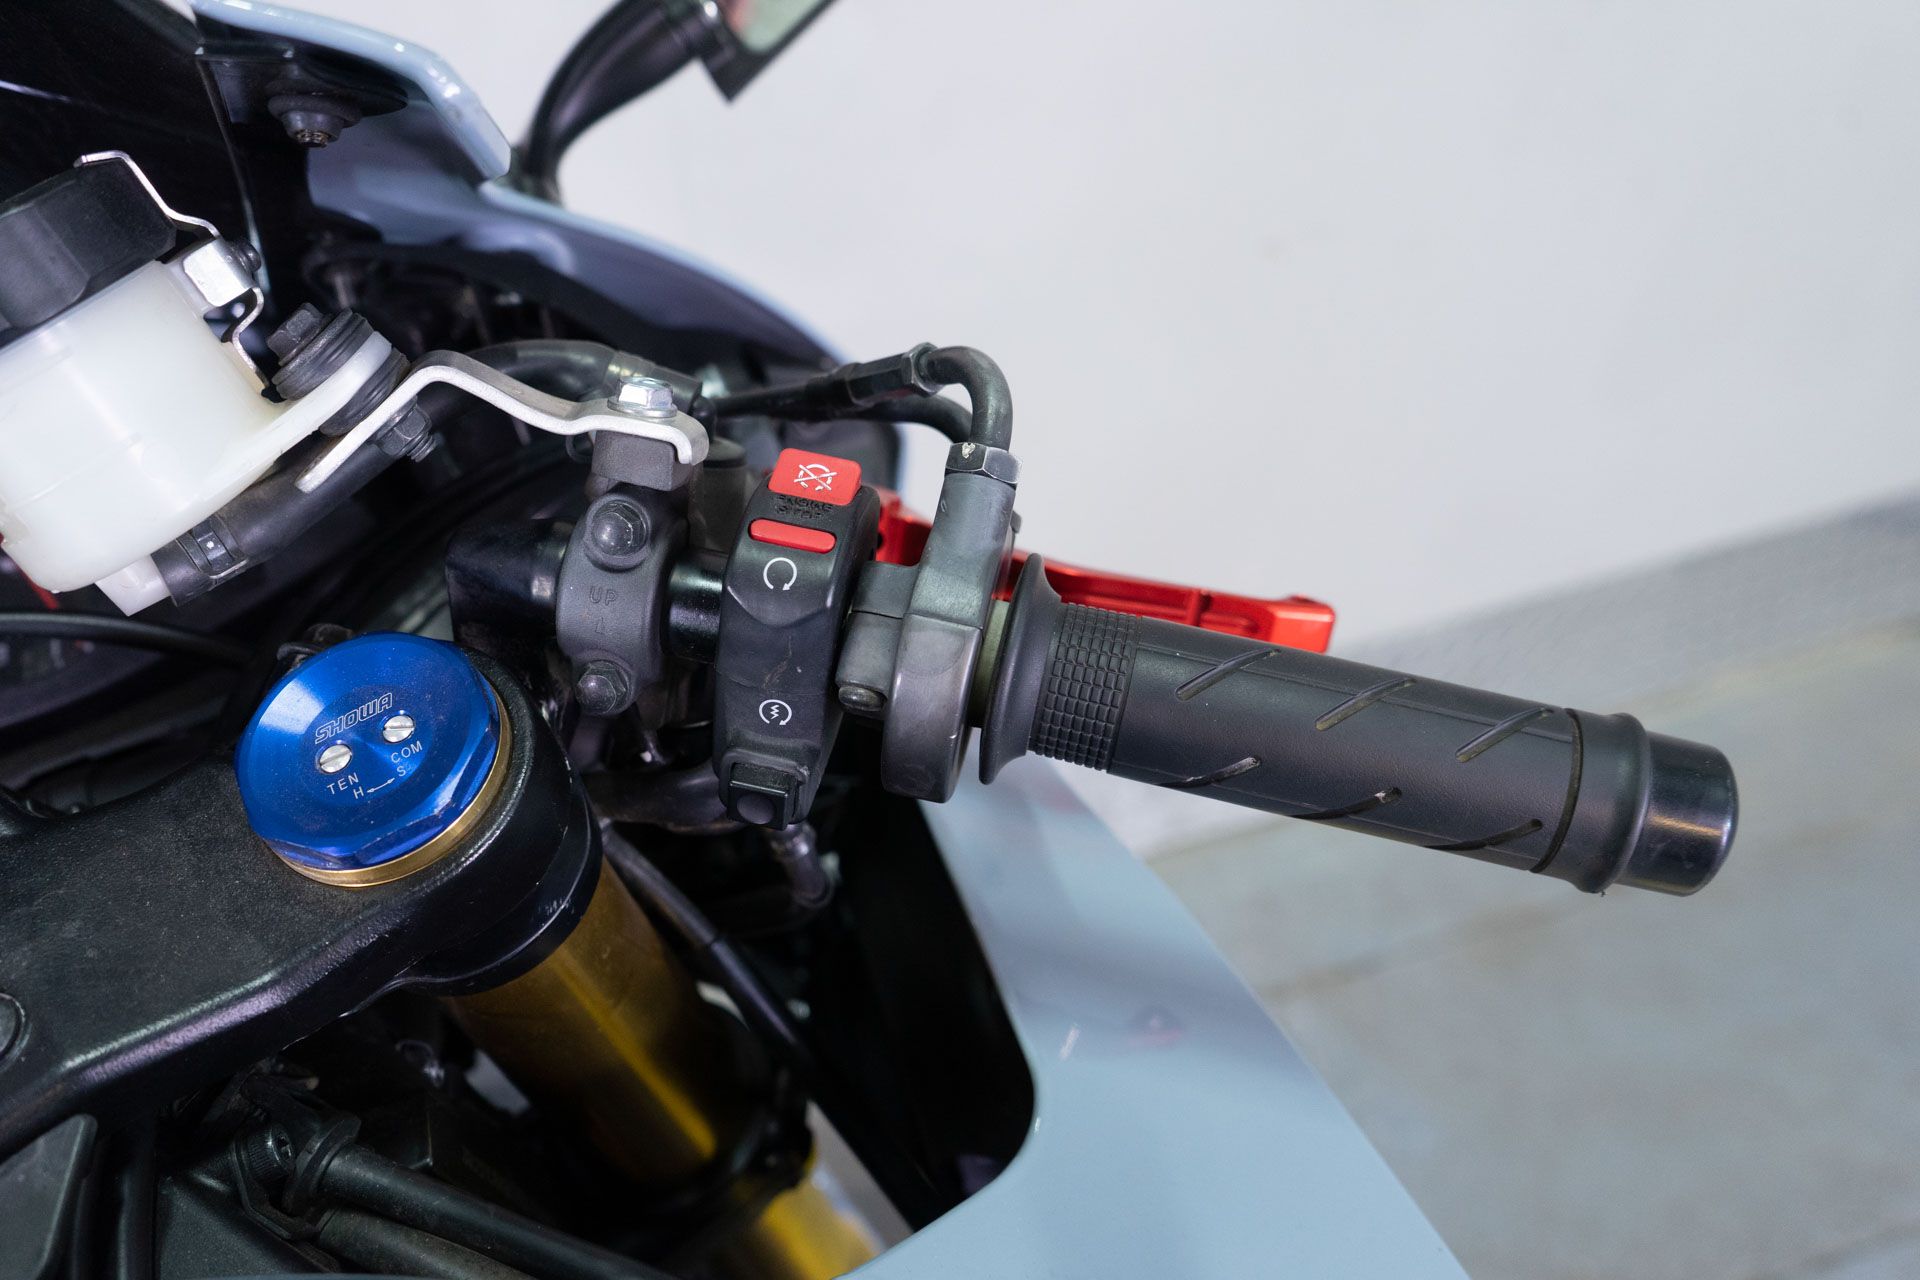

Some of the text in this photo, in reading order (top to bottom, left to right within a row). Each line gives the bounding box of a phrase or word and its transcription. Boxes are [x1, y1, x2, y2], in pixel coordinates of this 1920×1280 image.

[589, 585, 616, 606] UP
[314, 692, 393, 745] SHOWA
[390, 740, 423, 763] COM
[327, 772, 359, 795] TEN
[353, 765, 406, 799] H S
